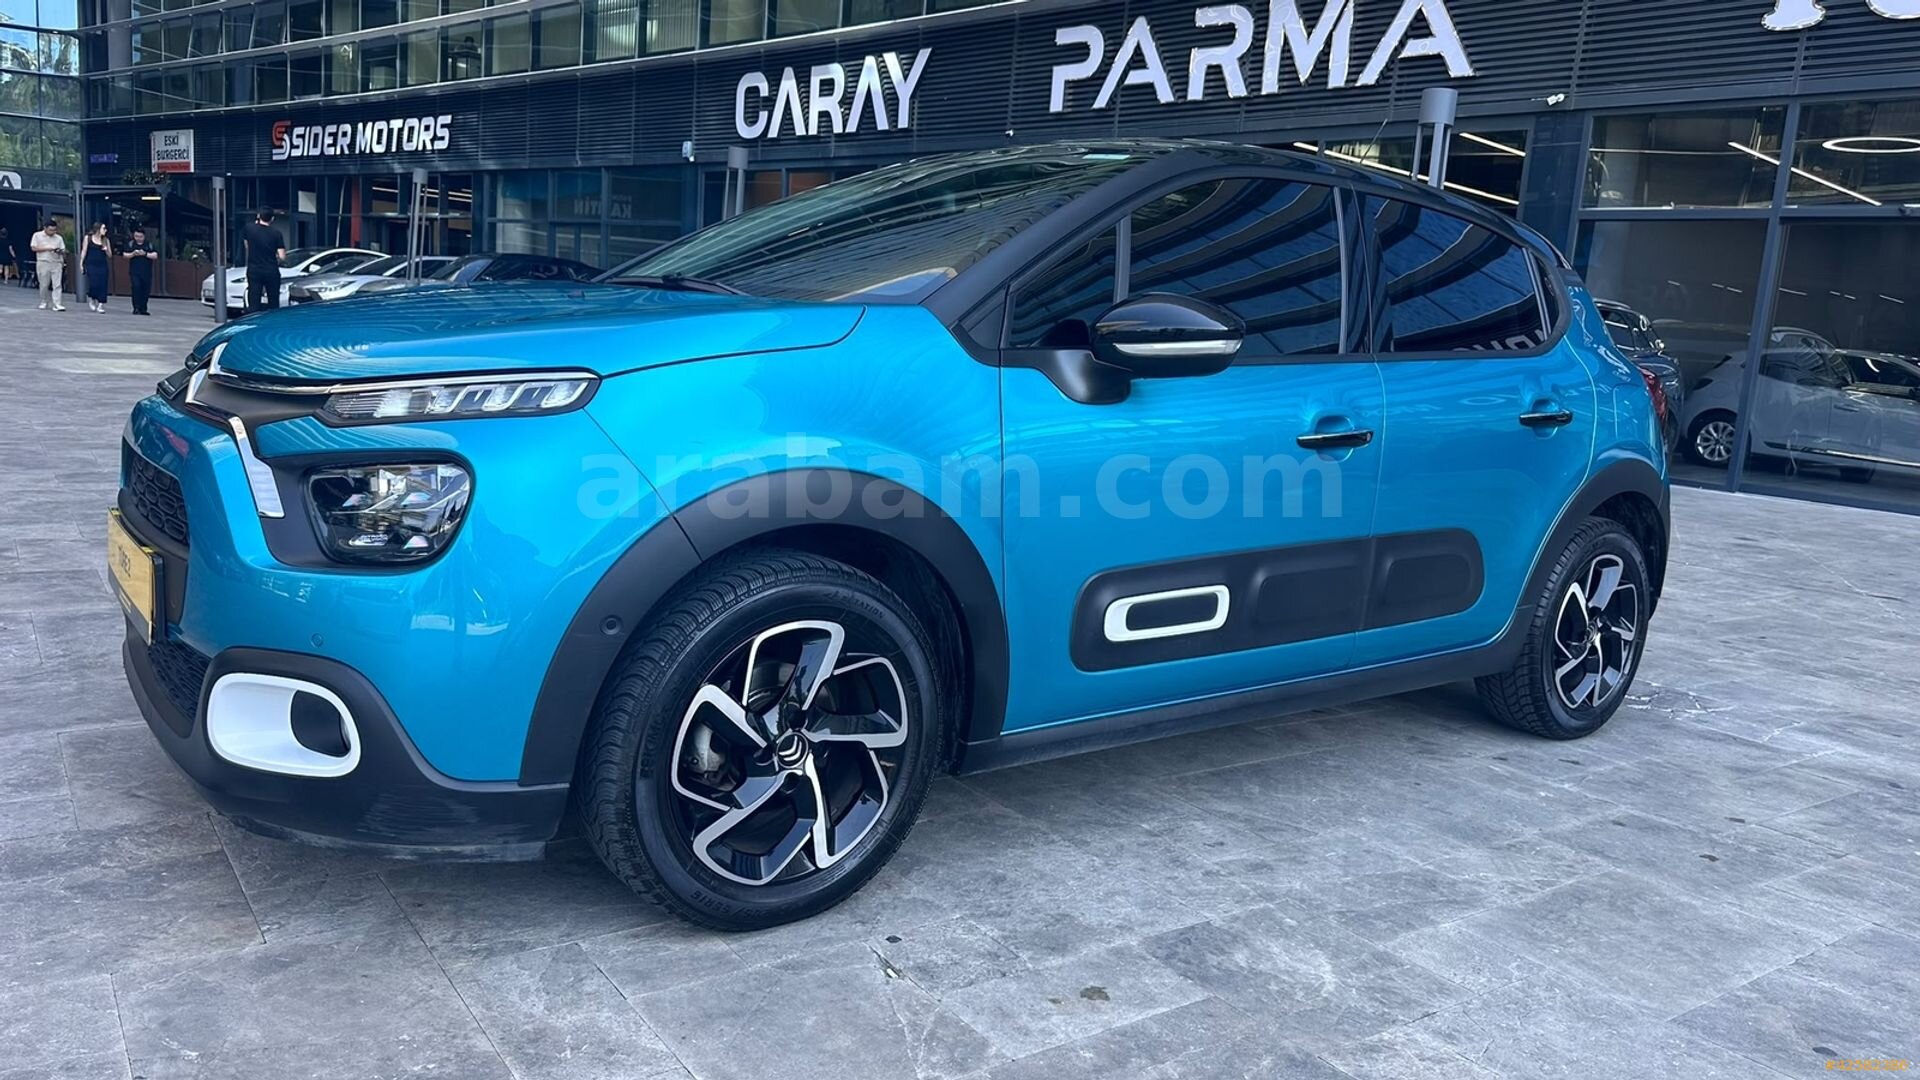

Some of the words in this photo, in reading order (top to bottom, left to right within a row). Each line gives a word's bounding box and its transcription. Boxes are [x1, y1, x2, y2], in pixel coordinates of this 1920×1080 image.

[735, 48, 932, 139] CARAY
[1050, 0, 1475, 113] PARMA
[290, 123, 352, 157] SIDER
[355, 115, 452, 154] MOTORS
